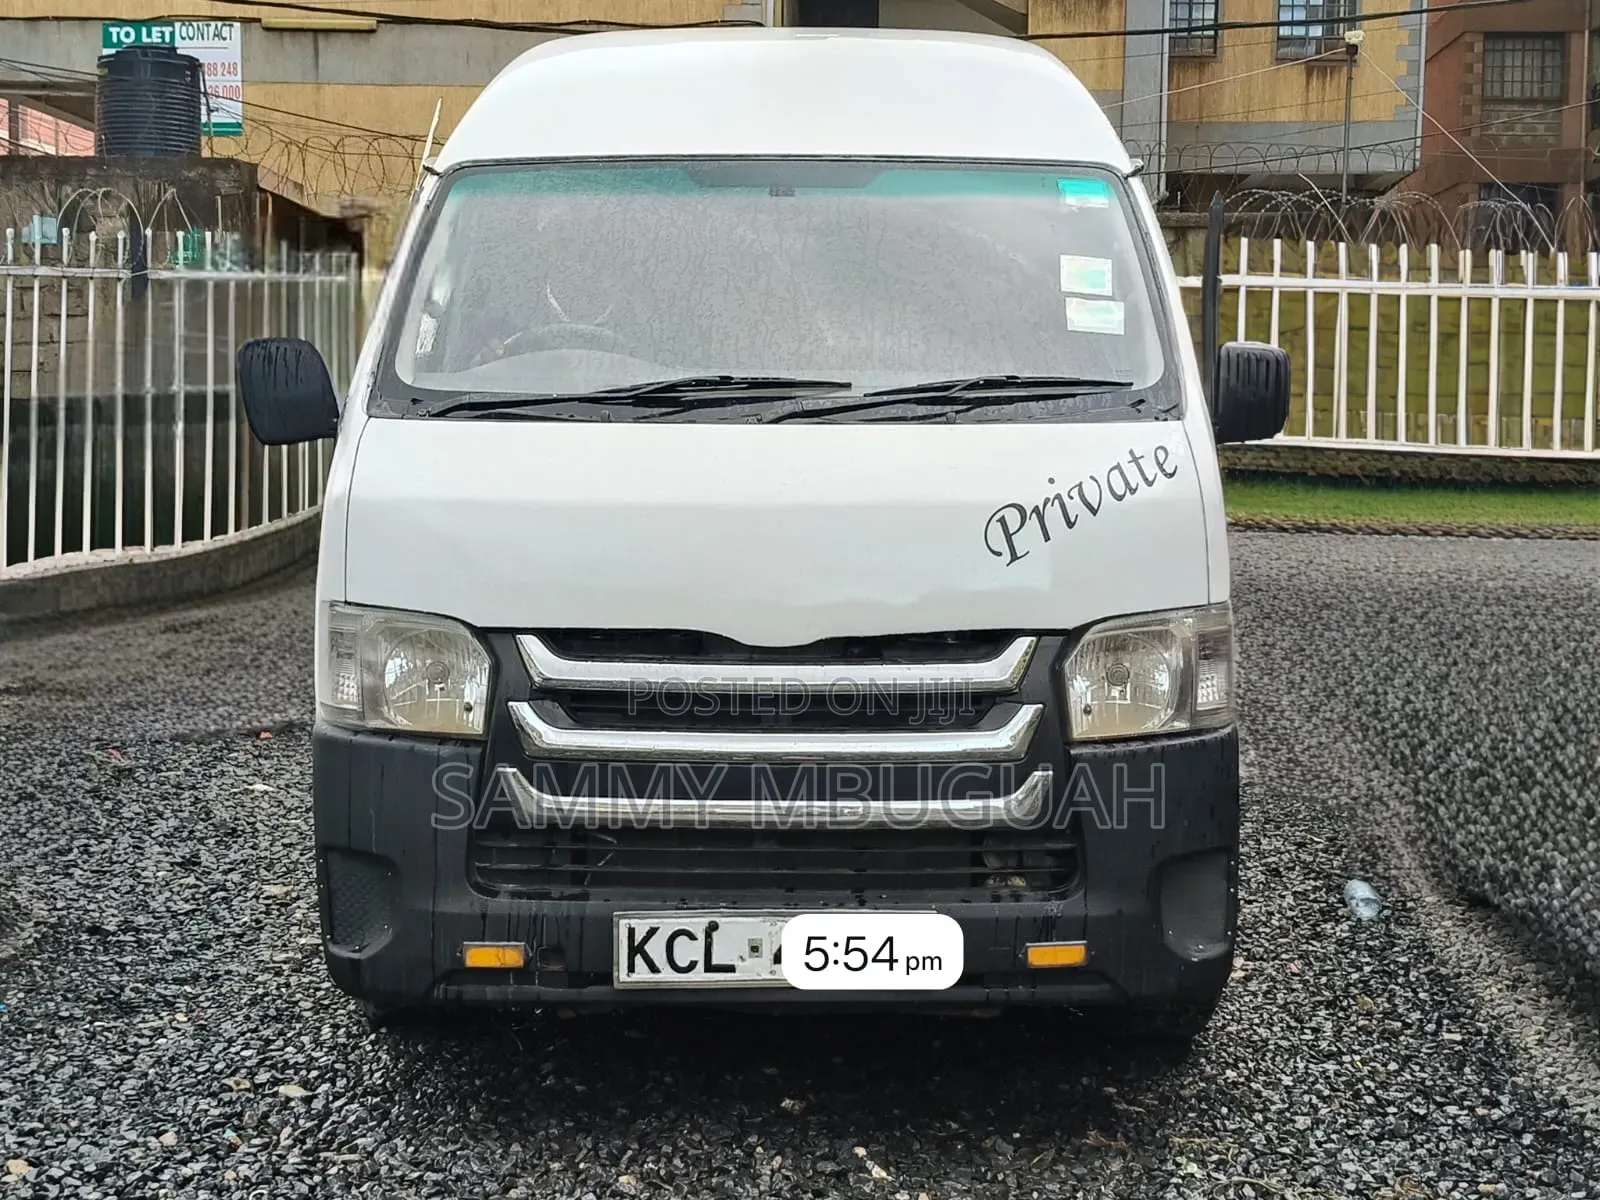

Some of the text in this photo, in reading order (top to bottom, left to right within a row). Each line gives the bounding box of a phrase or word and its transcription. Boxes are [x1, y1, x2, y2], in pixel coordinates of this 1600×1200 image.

[109, 26, 172, 43] TO LET
[179, 22, 234, 41] CONTACT
[221, 62, 238, 77] 248
[984, 445, 1178, 567] Private
[627, 926, 736, 974] KCL
